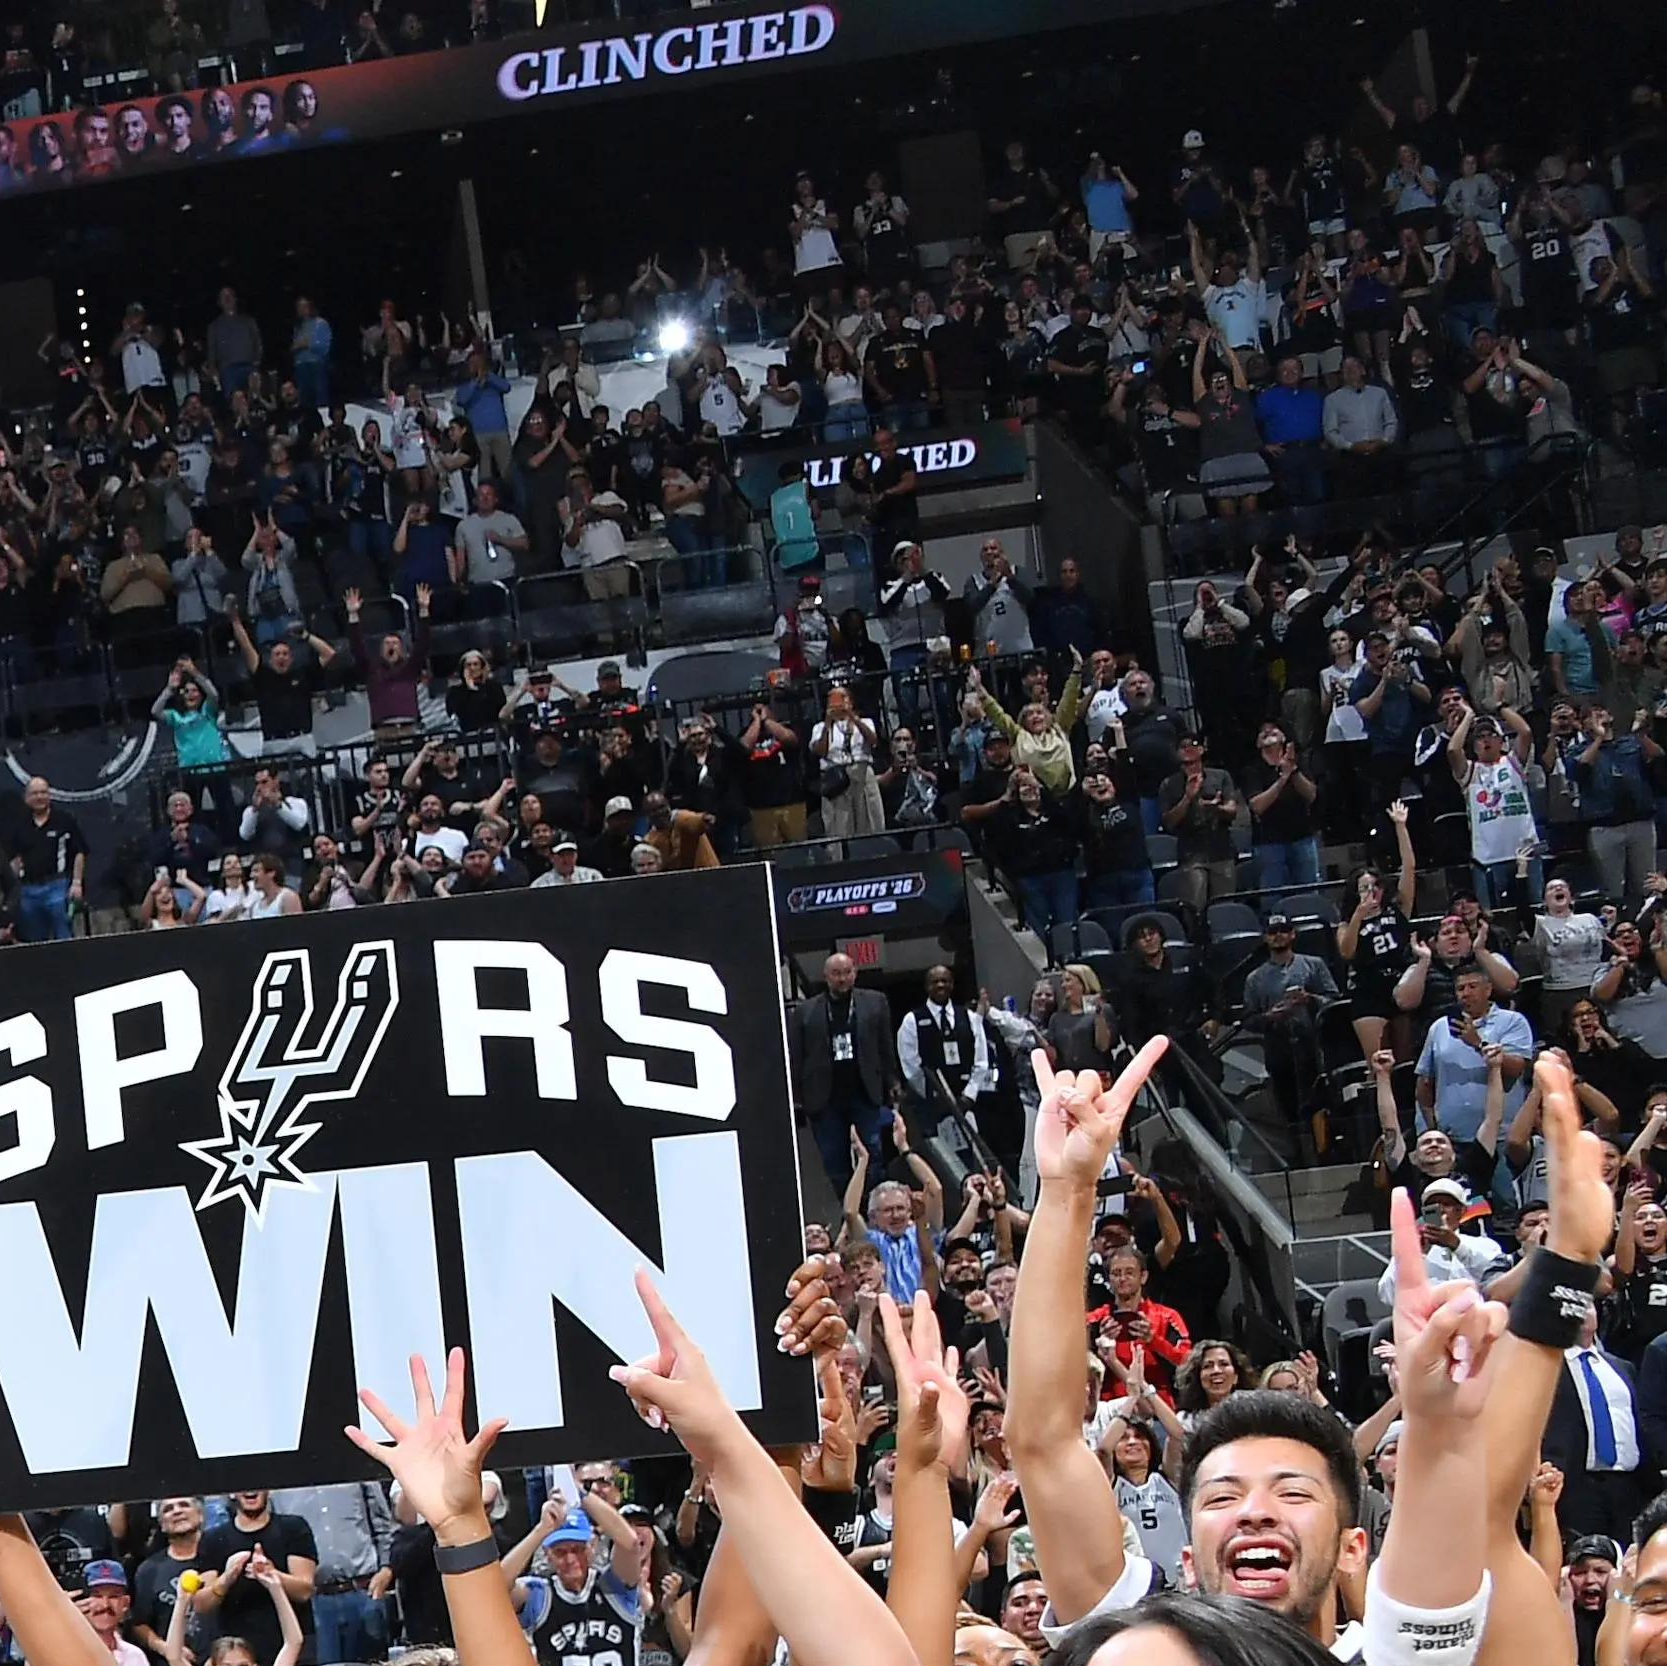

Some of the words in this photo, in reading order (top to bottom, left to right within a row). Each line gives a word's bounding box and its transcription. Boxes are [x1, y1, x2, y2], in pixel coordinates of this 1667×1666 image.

[497, 5, 836, 101] CLINCHED
[1531, 238, 1561, 261] 20
[995, 601, 1007, 616] 2
[815, 883, 887, 904] PLAYOFFS
[889, 879, 913, 895] '26
[1372, 931, 1399, 957] 21
[1141, 1509, 1158, 1530] 5
[550, 1619, 623, 1653] SPURS
